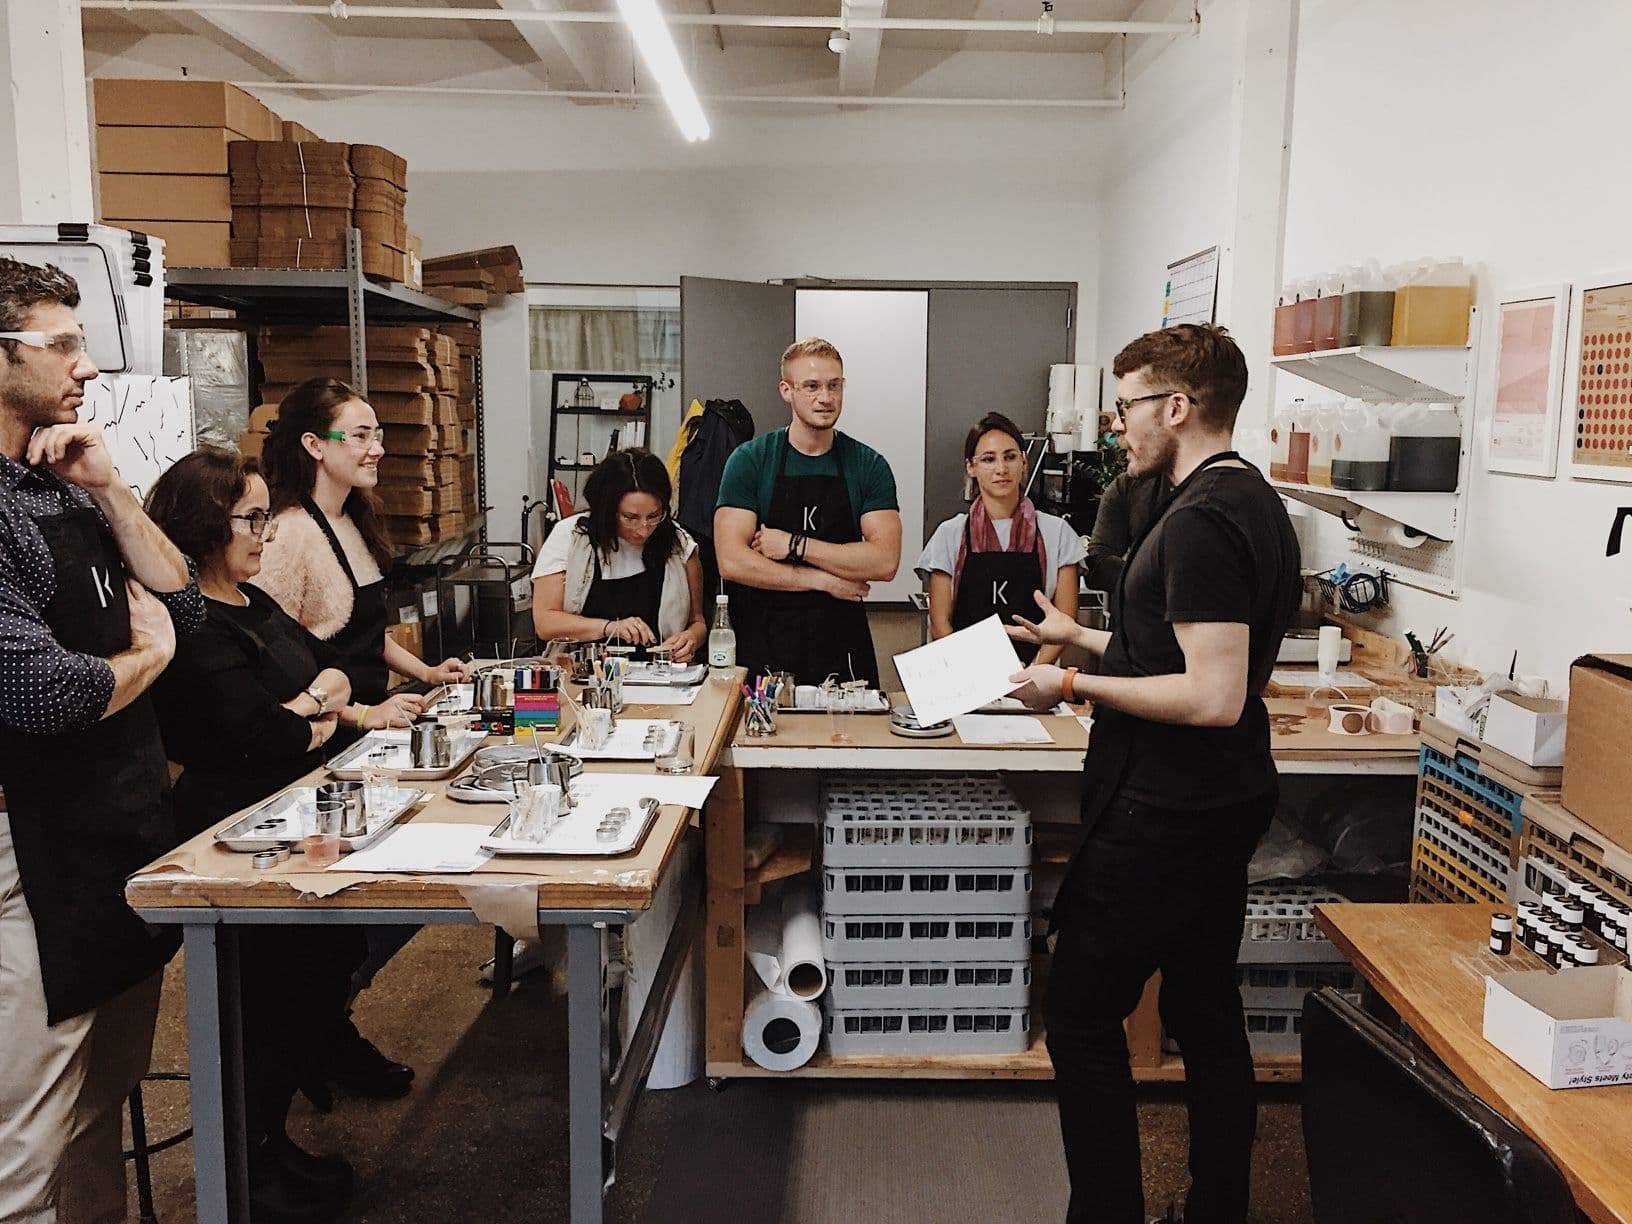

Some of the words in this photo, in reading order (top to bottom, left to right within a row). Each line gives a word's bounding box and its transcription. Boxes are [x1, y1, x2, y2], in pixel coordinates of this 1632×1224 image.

[804, 506, 818, 531] K
[91, 566, 115, 608] K
[993, 580, 1008, 605] K
[1568, 1075, 1593, 1085] Style!
[1594, 1074, 1619, 1083] Meets
